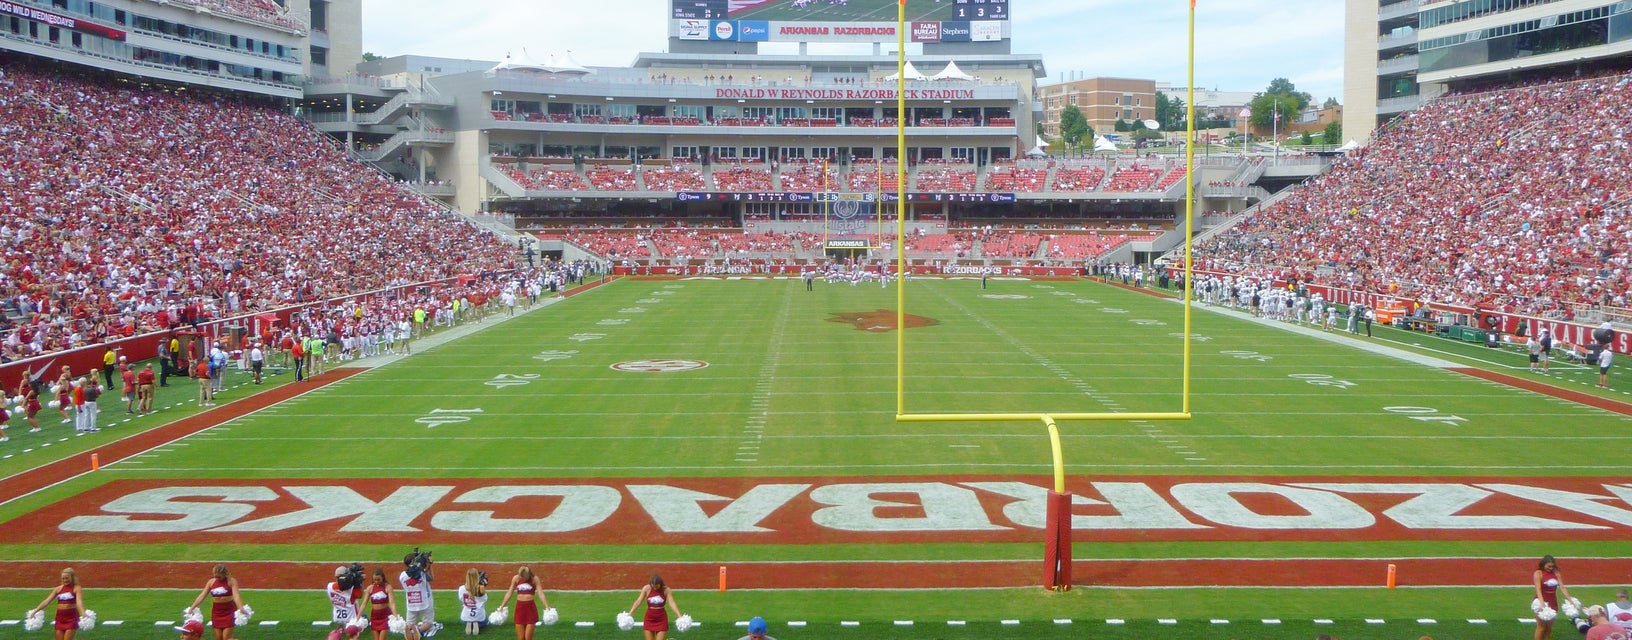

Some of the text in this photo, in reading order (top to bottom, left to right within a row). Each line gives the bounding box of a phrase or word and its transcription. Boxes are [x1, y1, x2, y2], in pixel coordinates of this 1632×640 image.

[12, 4, 30, 17] WILD
[30, 9, 75, 28] WEDNESDAYS!
[959, 8, 965, 17] 1
[977, 8, 984, 17] 3
[779, 26, 829, 35] ARKANSAS
[834, 27, 896, 36] RAZORBACKS
[942, 28, 969, 36] Stephens
[716, 88, 974, 99] DONALD W REYNOLDS RAZORBACK STADIUM
[943, 266, 1002, 274] RZORBACKS
[1525, 318, 1629, 354] AKANSS
[58, 482, 1632, 533] AZORBACKS
[336, 609, 348, 619] 26
[469, 607, 477, 617] 5
